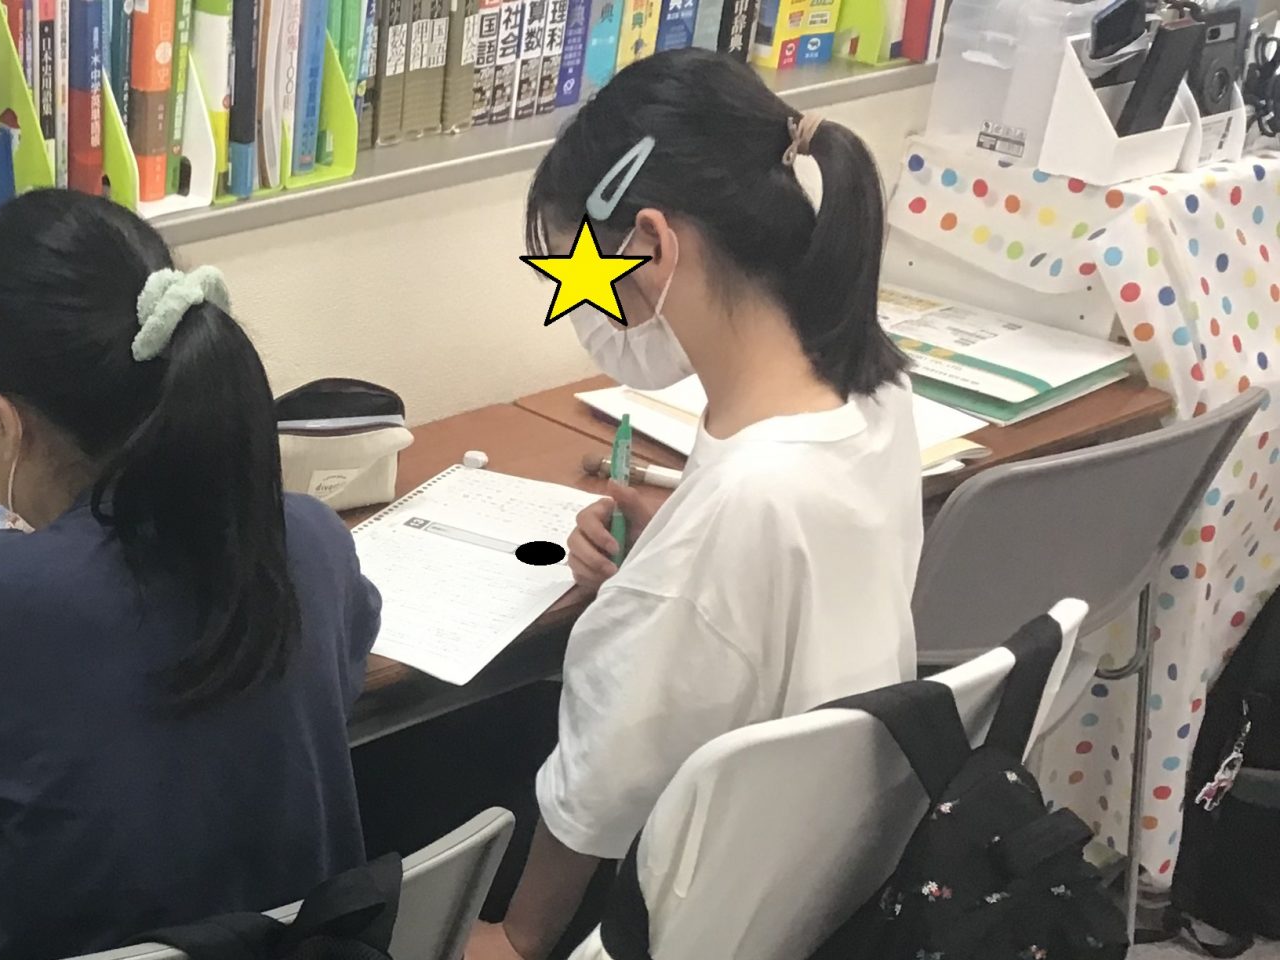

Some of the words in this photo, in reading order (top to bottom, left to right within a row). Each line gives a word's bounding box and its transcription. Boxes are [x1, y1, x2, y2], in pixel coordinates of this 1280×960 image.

[476, 12, 499, 65] 国語
[498, 4, 520, 58] 社会
[545, 0, 565, 51] 理科
